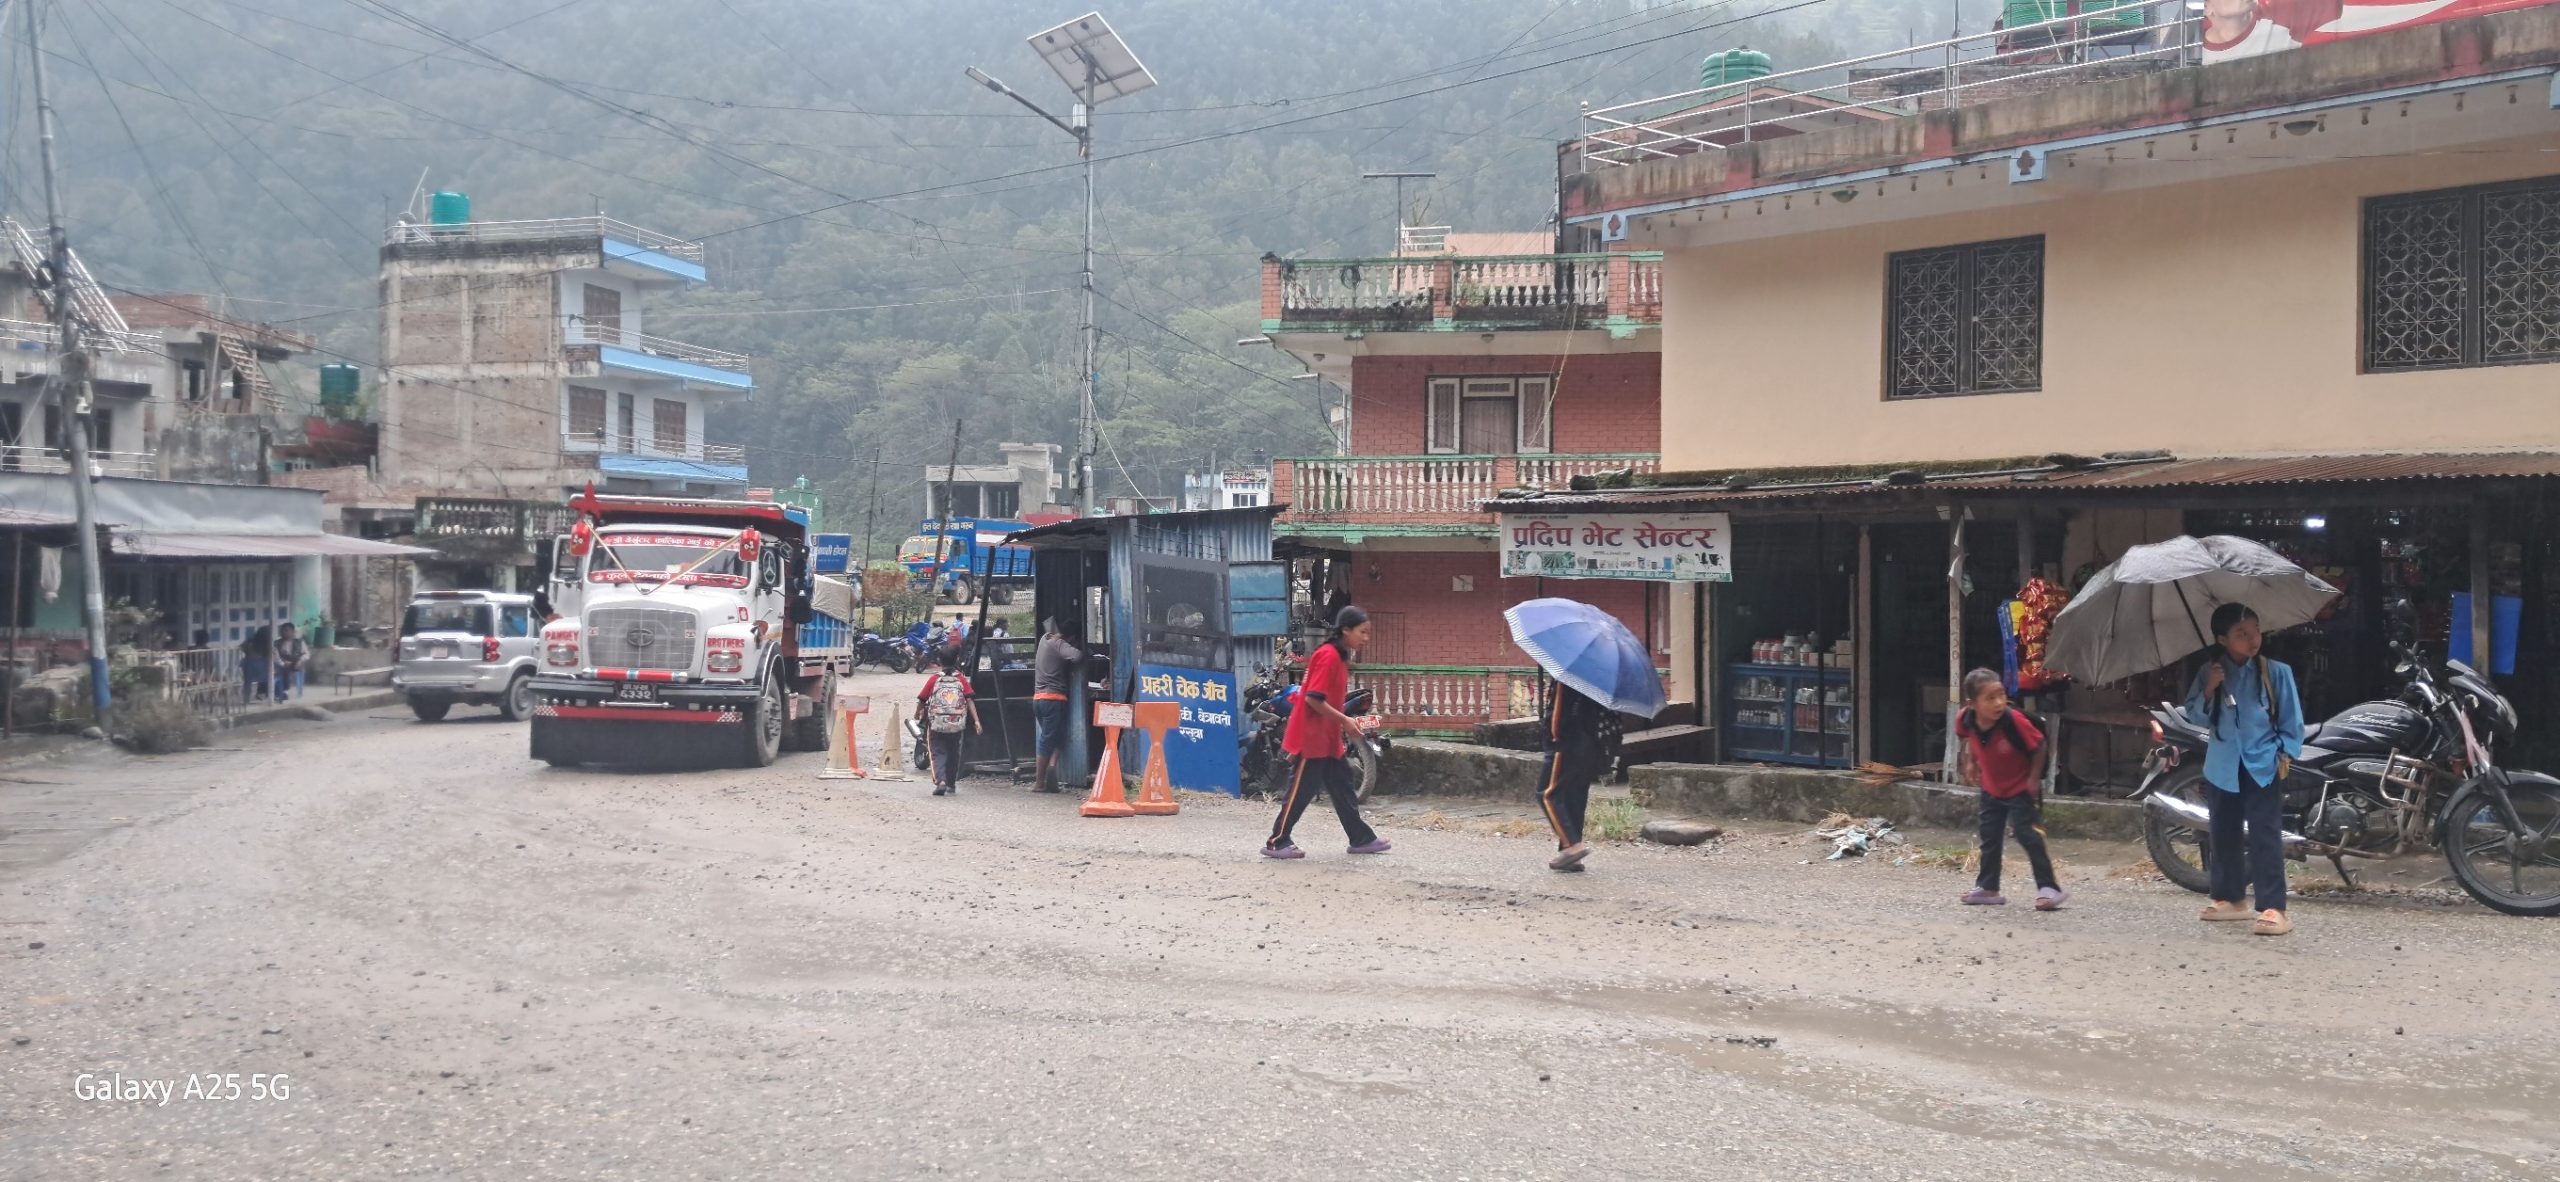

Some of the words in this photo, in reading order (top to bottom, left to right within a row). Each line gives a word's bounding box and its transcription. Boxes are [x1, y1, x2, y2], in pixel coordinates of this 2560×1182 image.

[1512, 521, 1574, 548] प्रदिप
[1582, 521, 1624, 547] भेट
[1633, 521, 1717, 549] सेन्टर
[708, 637, 745, 648] BROTHERS
[1142, 674, 1173, 697] प्रहरी
[1176, 675, 1200, 699] चेक
